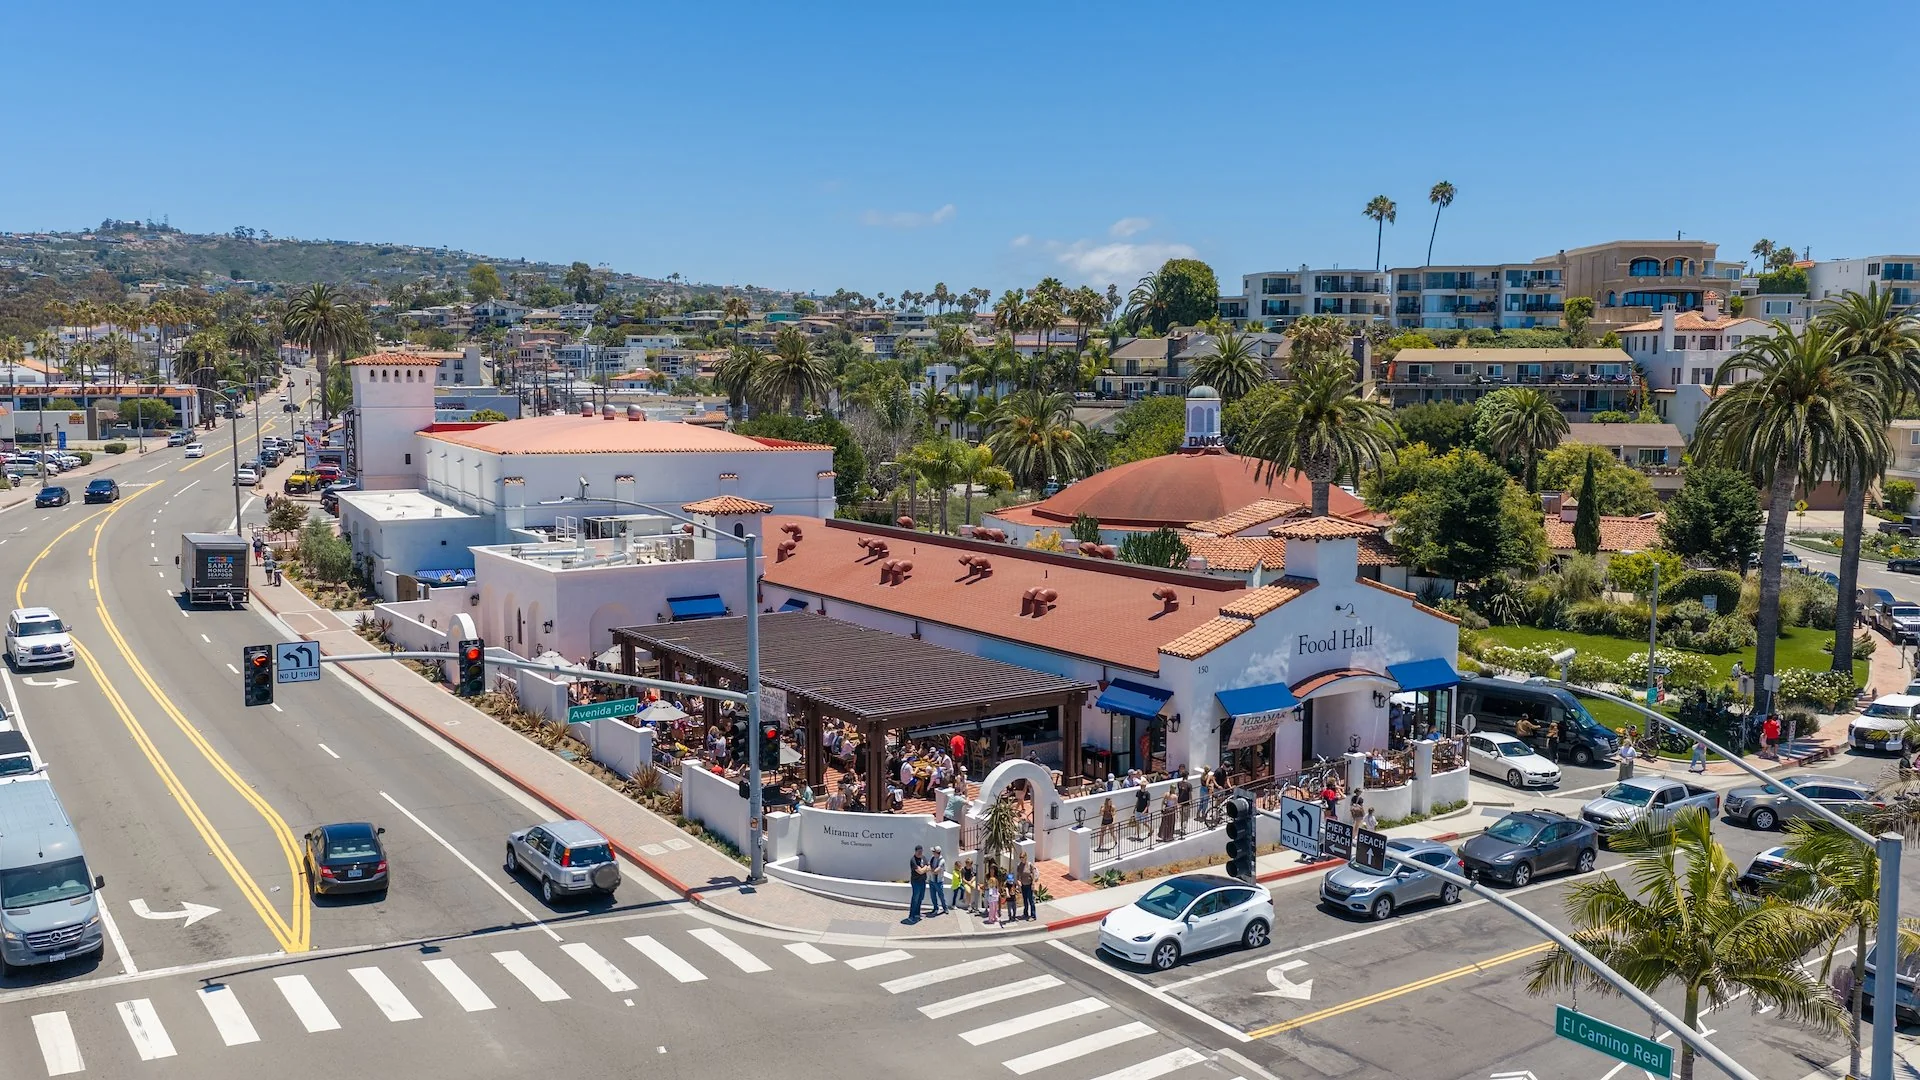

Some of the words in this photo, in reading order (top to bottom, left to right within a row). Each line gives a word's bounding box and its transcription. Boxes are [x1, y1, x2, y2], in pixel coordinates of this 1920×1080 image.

[346, 414, 355, 463] MIRAMAR
[1298, 630, 1336, 655] Food
[1342, 626, 1373, 650] Hall
[291, 671, 298, 680] U
[1198, 665, 1209, 674] 150
[571, 706, 612, 720] Avenida
[614, 703, 635, 713] Pico
[1241, 711, 1287, 726] MIRAMAR
[823, 825, 859, 838] Miramar
[861, 829, 894, 839] Center
[1326, 821, 1344, 835] PIER
[1344, 827, 1352, 837] &
[1282, 834, 1291, 843] NO
[1292, 836, 1299, 847] U
[1301, 840, 1317, 852] TURN
[1326, 833, 1351, 847] BEACH
[1359, 833, 1385, 849] BEACH
[1562, 1016, 1575, 1034] El
[1578, 1023, 1630, 1055] Camino
[1633, 1043, 1663, 1069] Real
